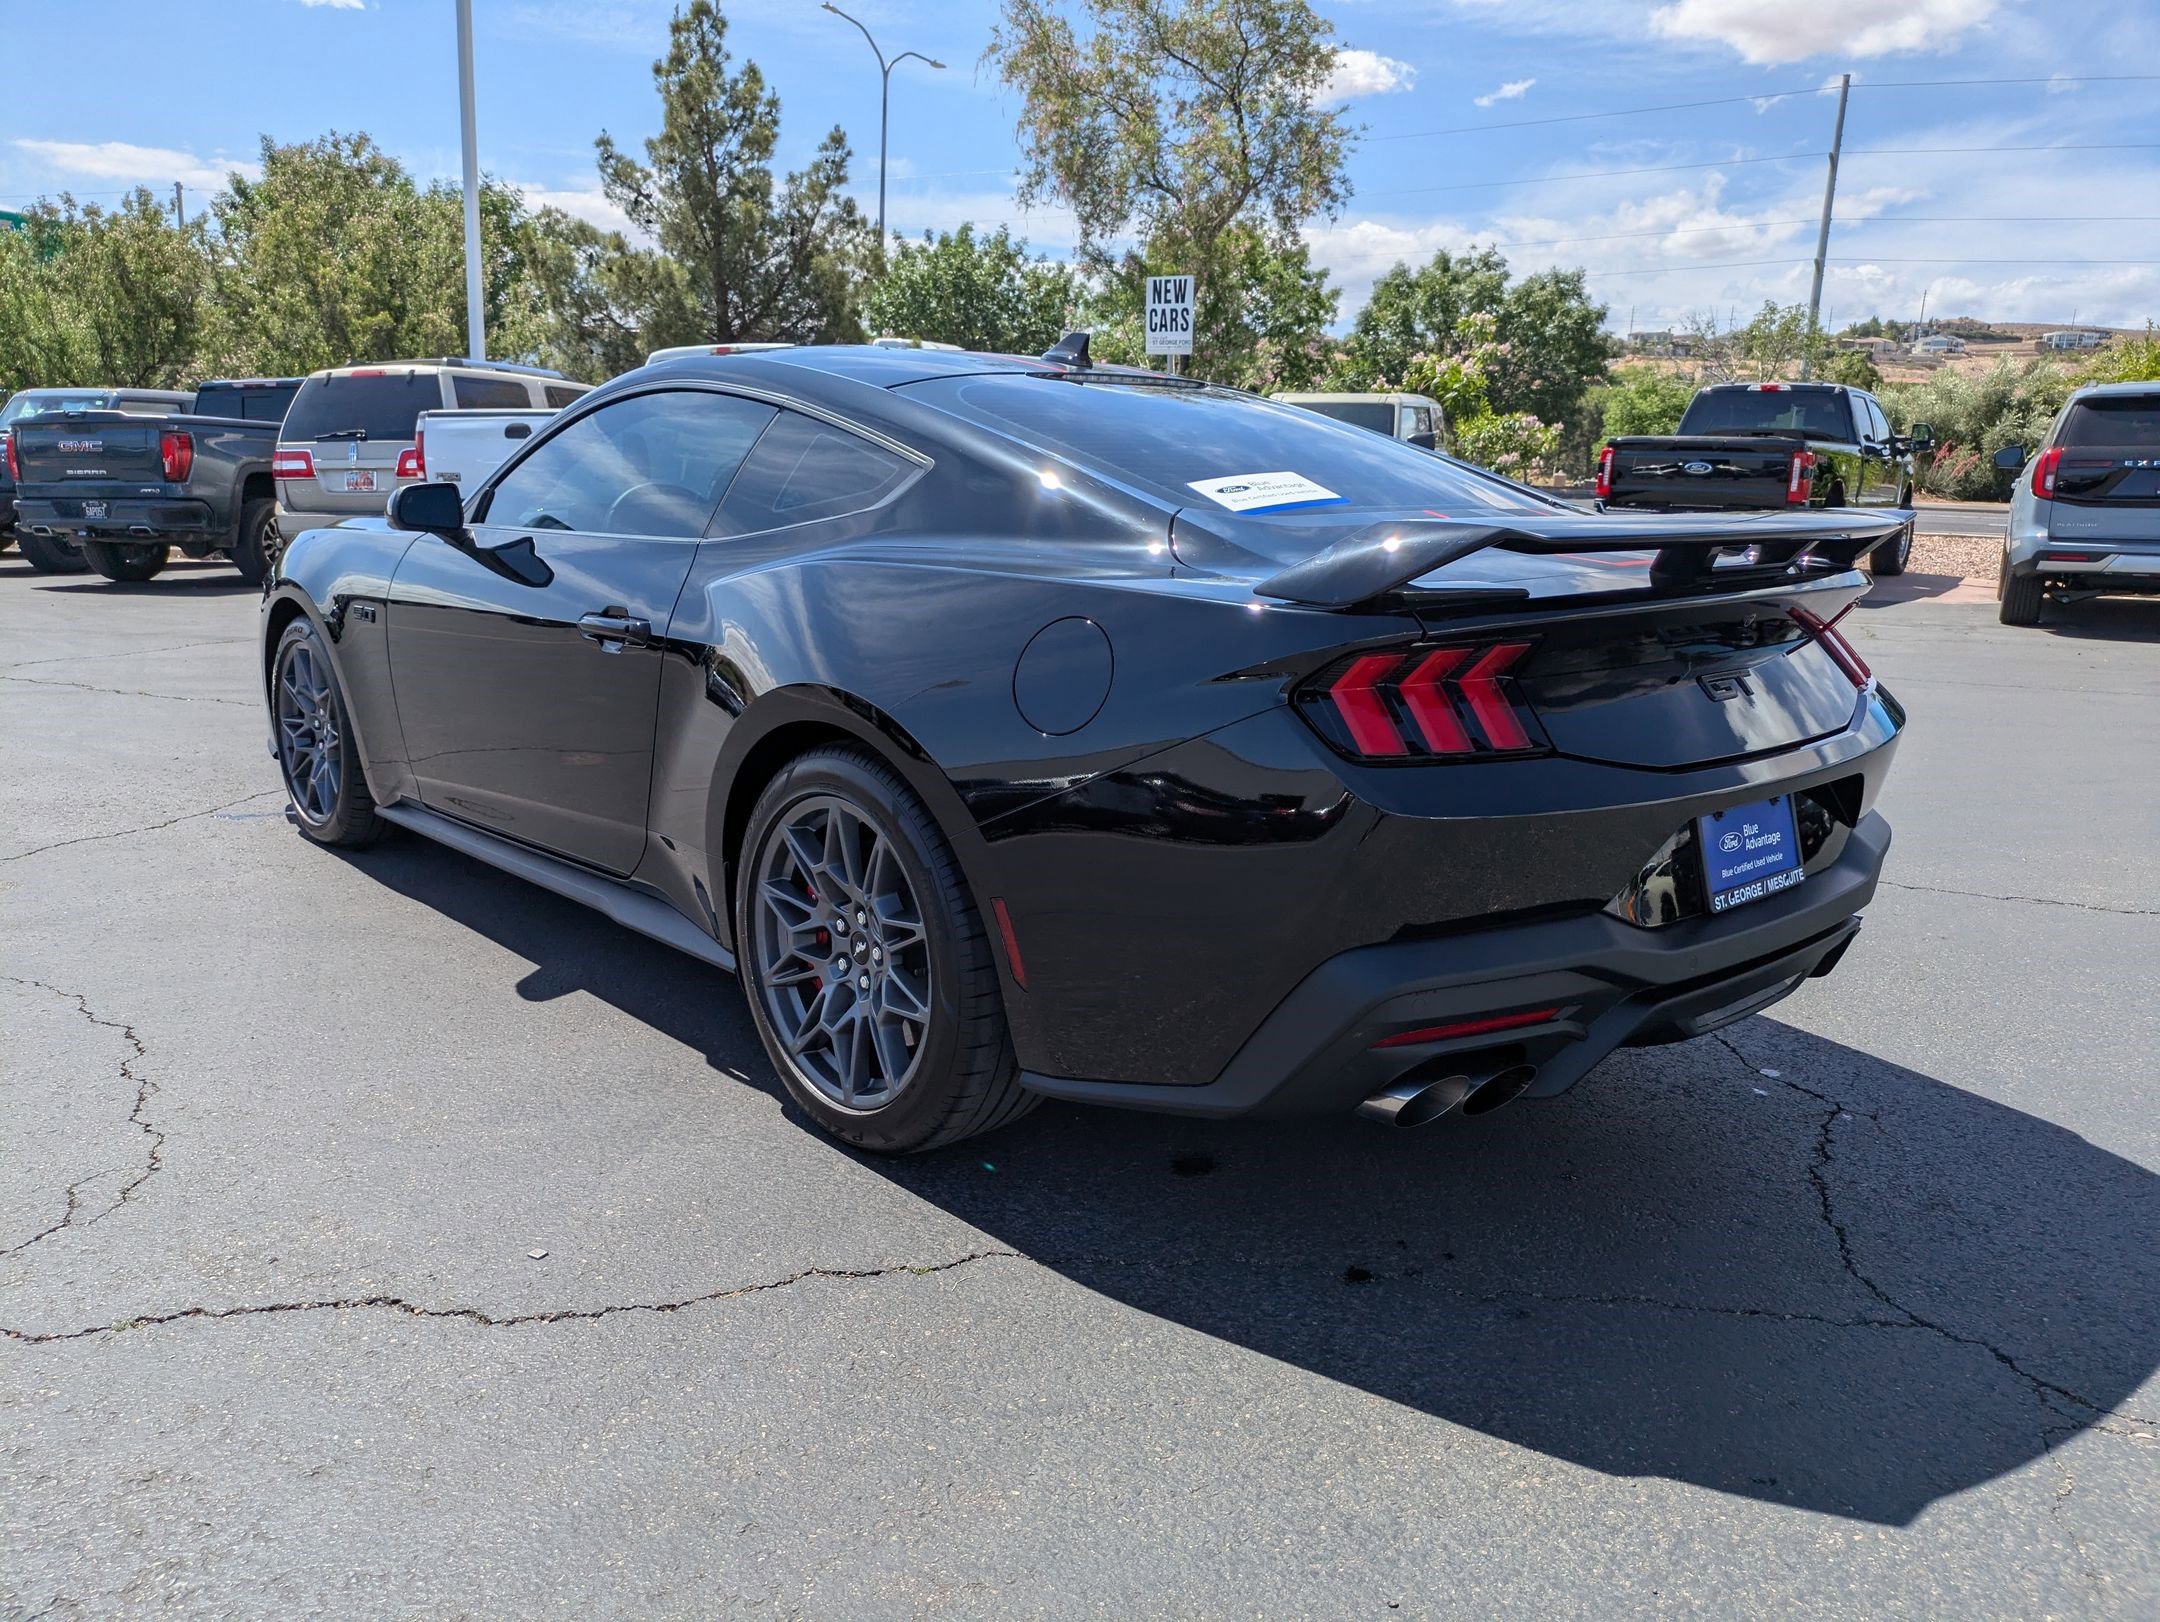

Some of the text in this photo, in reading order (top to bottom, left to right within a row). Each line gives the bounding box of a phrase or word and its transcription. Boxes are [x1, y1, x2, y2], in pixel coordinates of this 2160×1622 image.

[1152, 279, 1188, 304] NEW
[1149, 307, 1190, 333] CARS
[59, 440, 103, 452] GMC
[1695, 667, 1754, 703] GT
[1742, 823, 1759, 837] Blue
[1745, 831, 1781, 851] Advantage
[1721, 852, 1784, 878] Blue Certified Used Vehicle
[1714, 896, 1728, 910] ST.
[1728, 883, 1764, 906] GEORGE
[1767, 868, 1805, 891] MESQUITE
